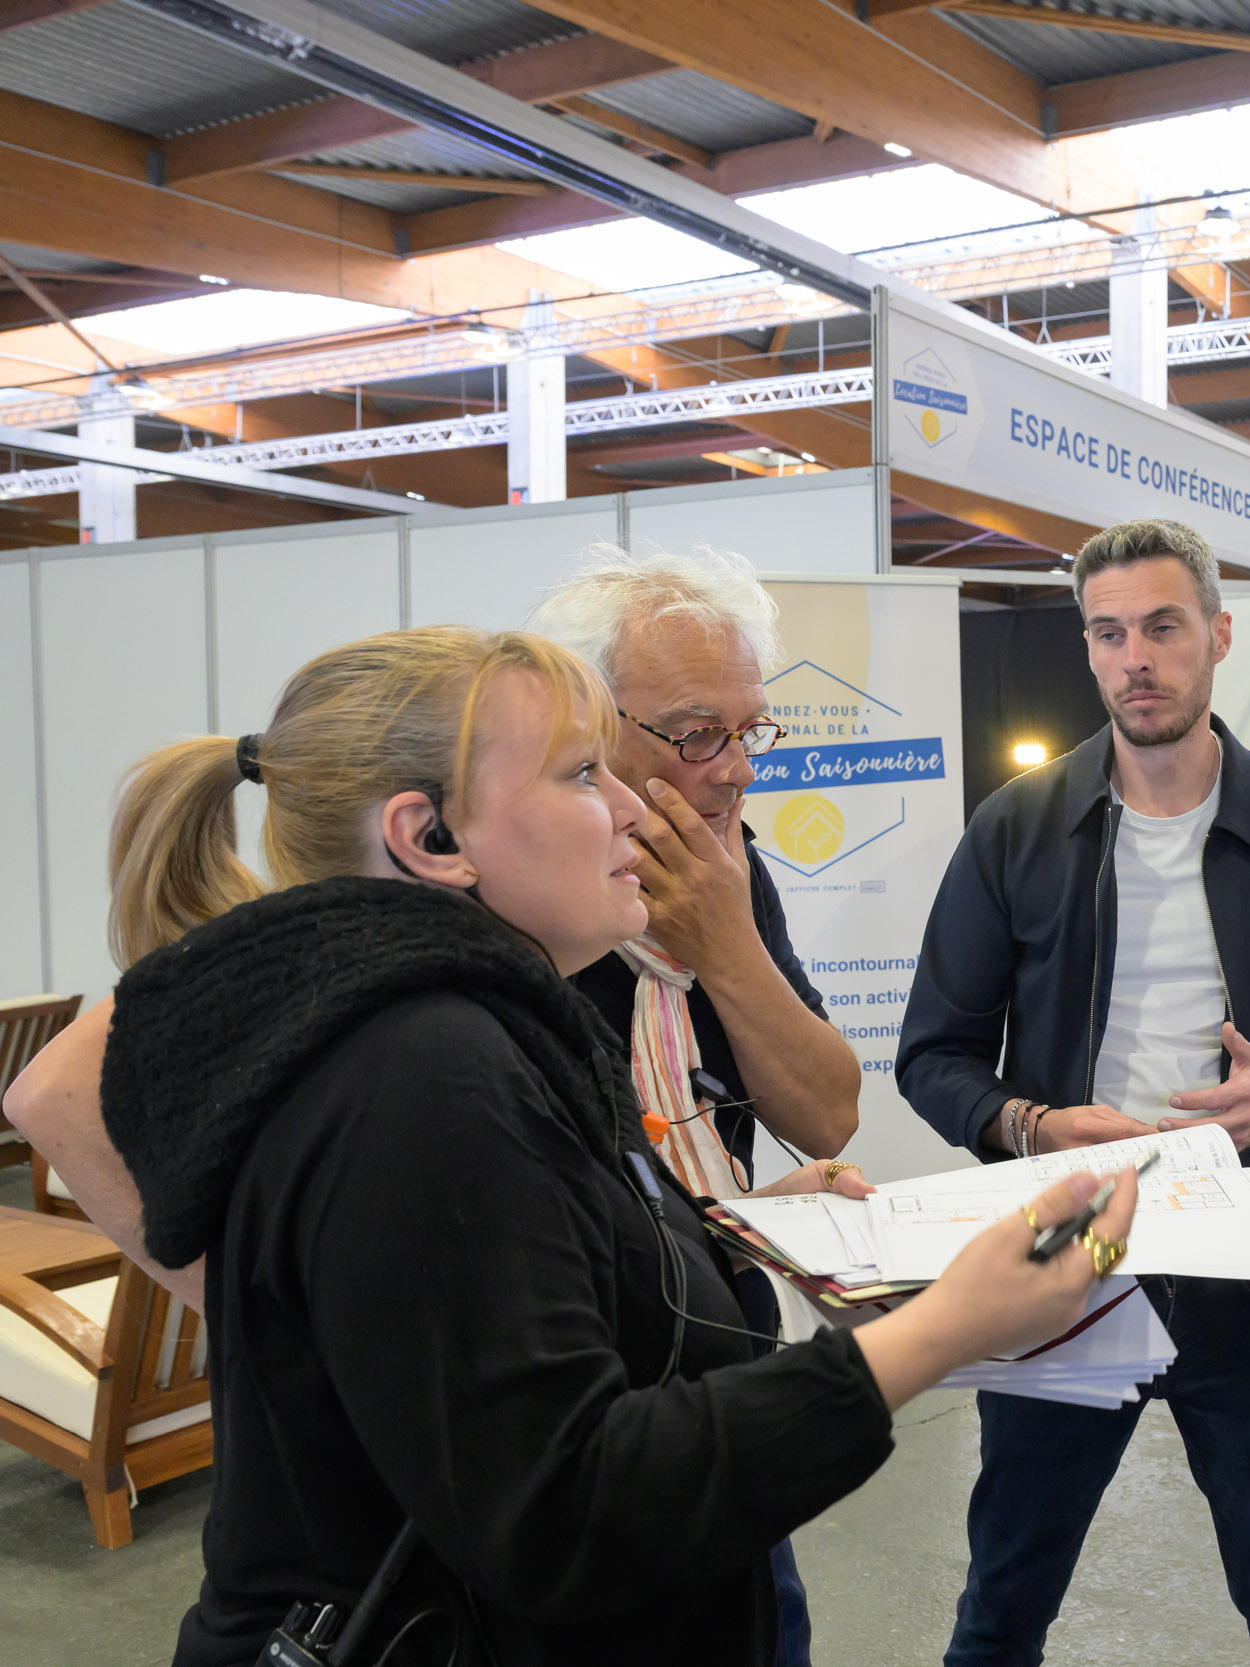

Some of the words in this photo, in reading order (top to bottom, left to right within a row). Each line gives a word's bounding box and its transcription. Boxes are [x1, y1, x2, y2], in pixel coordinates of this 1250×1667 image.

[1011, 408, 1100, 468] ESPACE
[1107, 443, 1131, 479] DE
[827, 724, 845, 735] DE
[852, 724, 869, 735] LA
[801, 751, 942, 782] Saisonnière
[829, 994, 860, 1006] son
[866, 987, 912, 1005] activ
[862, 1059, 893, 1074] exp
